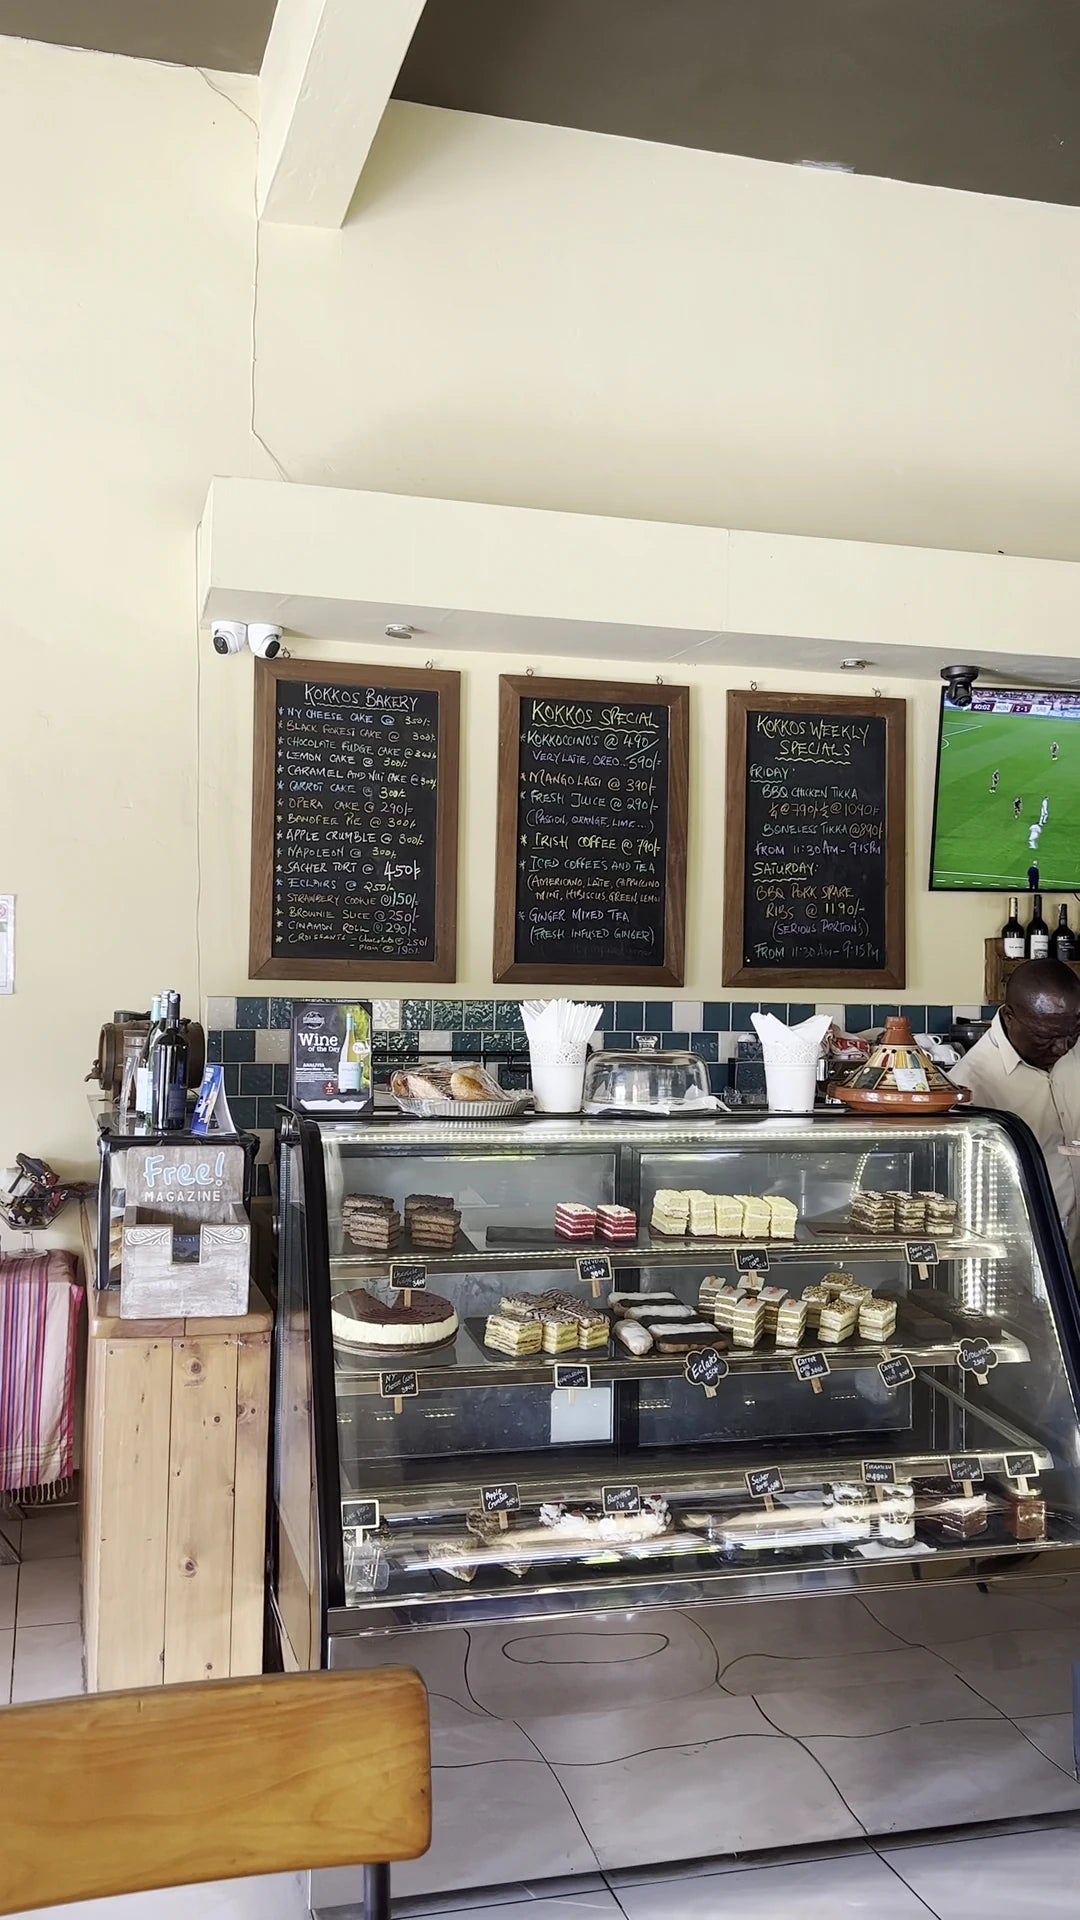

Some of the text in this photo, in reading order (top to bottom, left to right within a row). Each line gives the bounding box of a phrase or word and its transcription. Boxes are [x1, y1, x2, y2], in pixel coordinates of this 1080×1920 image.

[304, 684, 418, 711] KOKKOS BAKERY
[288, 707, 301, 718] NY
[306, 709, 343, 721] CHEESE
[350, 713, 373, 723] CAKE
[381, 715, 395, 725] @
[532, 700, 659, 728] KOKKOS SPECIAL
[287, 720, 400, 742] BLACK FOREST CAKE @
[757, 715, 869, 747] KOKKOS WEEKLY
[287, 737, 336, 749] CHOCOLATE
[342, 741, 374, 755] FUDGE
[378, 746, 400, 757] CAKE
[604, 734, 618, 750] @
[780, 740, 850, 756] SPECIALS
[286, 750, 321, 761] LEMON
[329, 754, 355, 765] CAKE
[533, 750, 560, 764] VERY
[287, 765, 343, 778] CARAMEL
[347, 770, 366, 780] AND
[368, 770, 384, 782] NUT
[387, 772, 407, 784] CAKE
[529, 769, 574, 786] MANGO
[577, 775, 601, 787] LASSI
[608, 777, 620, 790] @
[289, 780, 324, 792] CARROT
[330, 785, 356, 793] CAKE
[762, 784, 857, 799] BBQ CHICKEN TIKKA
[289, 797, 324, 810] OPERA
[334, 800, 360, 810] CAKE
[364, 801, 374, 813] @
[531, 790, 564, 804] FRESH
[571, 793, 606, 807] JUICE
[610, 798, 622, 811] @
[287, 812, 381, 828] BANOFEE PIE @
[286, 829, 320, 841] APPLE
[325, 832, 376, 843] CRUMBLE
[381, 833, 392, 844] @
[762, 824, 817, 837] BONELESS
[820, 822, 847, 834] TIKKA
[287, 845, 361, 858] NAPOLEON @
[532, 833, 568, 849] IRISH
[578, 835, 617, 849] COFFEE
[622, 839, 632, 855] @
[755, 842, 784, 856] FROM
[284, 863, 327, 874] SACHER
[333, 862, 357, 873] TORT
[362, 864, 374, 874] @
[529, 856, 559, 871] ICED
[611, 861, 631, 871] AND
[634, 860, 655, 874] TEA
[288, 878, 336, 889] ECLAIRS
[346, 881, 357, 891] @
[616, 878, 660, 888] CAPPUCCINO
[535, 890, 563, 901] MINT,
[756, 883, 854, 901] BBQ PORK SPARE
[345, 897, 376, 906] COOKIE
[289, 907, 335, 918] BROWNIE
[343, 910, 370, 919] SLICE
[375, 911, 386, 922] @
[529, 908, 630, 923] GINGER MIXED TEA
[766, 903, 794, 919] RIBS
[806, 903, 817, 918] @
[288, 921, 333, 931] CINAMON
[343, 923, 369, 934] ROLL
[530, 926, 655, 946] (FRESH INFUSED GINGER)
[753, 942, 784, 959] FROM
[298, 1033, 338, 1046] Wine
[143, 1152, 225, 1187] Free!
[144, 1191, 220, 1202] MAGAZINE
[963, 1347, 990, 1362] Brownie
[692, 1353, 717, 1379] Eclairs
[386, 1374, 398, 1383] NY
